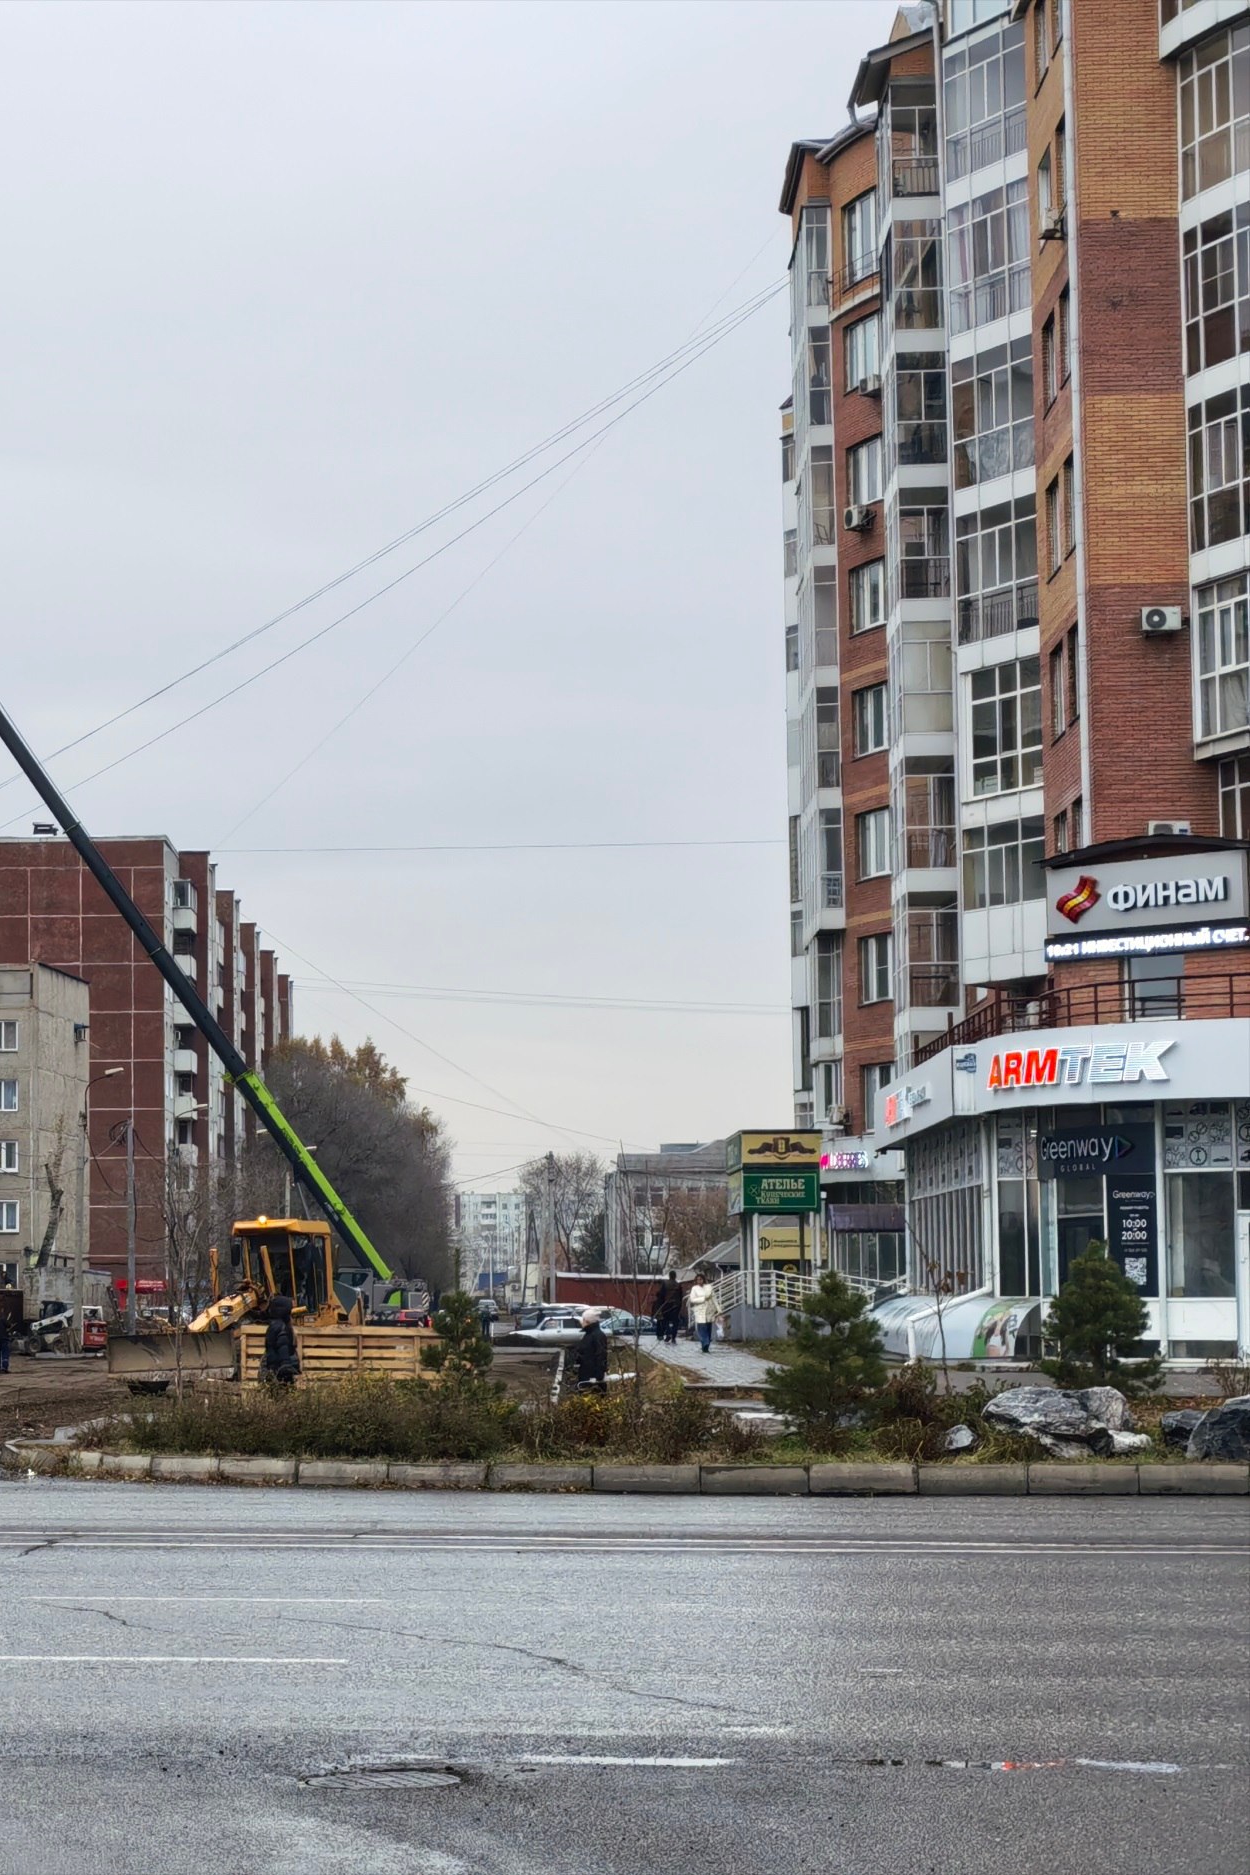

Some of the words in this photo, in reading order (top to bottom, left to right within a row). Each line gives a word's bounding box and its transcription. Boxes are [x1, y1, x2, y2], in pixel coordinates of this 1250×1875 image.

[1081, 927, 1210, 952] ИНВЕСТИЦИОННЫЙ
[987, 1040, 1177, 1091] ARMTEK
[1040, 1136, 1114, 1162] Greenway
[1060, 1163, 1096, 1173] GLOBAL
[761, 1178, 806, 1190] АТЕЛЬЕ
[1122, 1219, 1147, 1228] 10:00
[1121, 1231, 1147, 1240] 20:00
